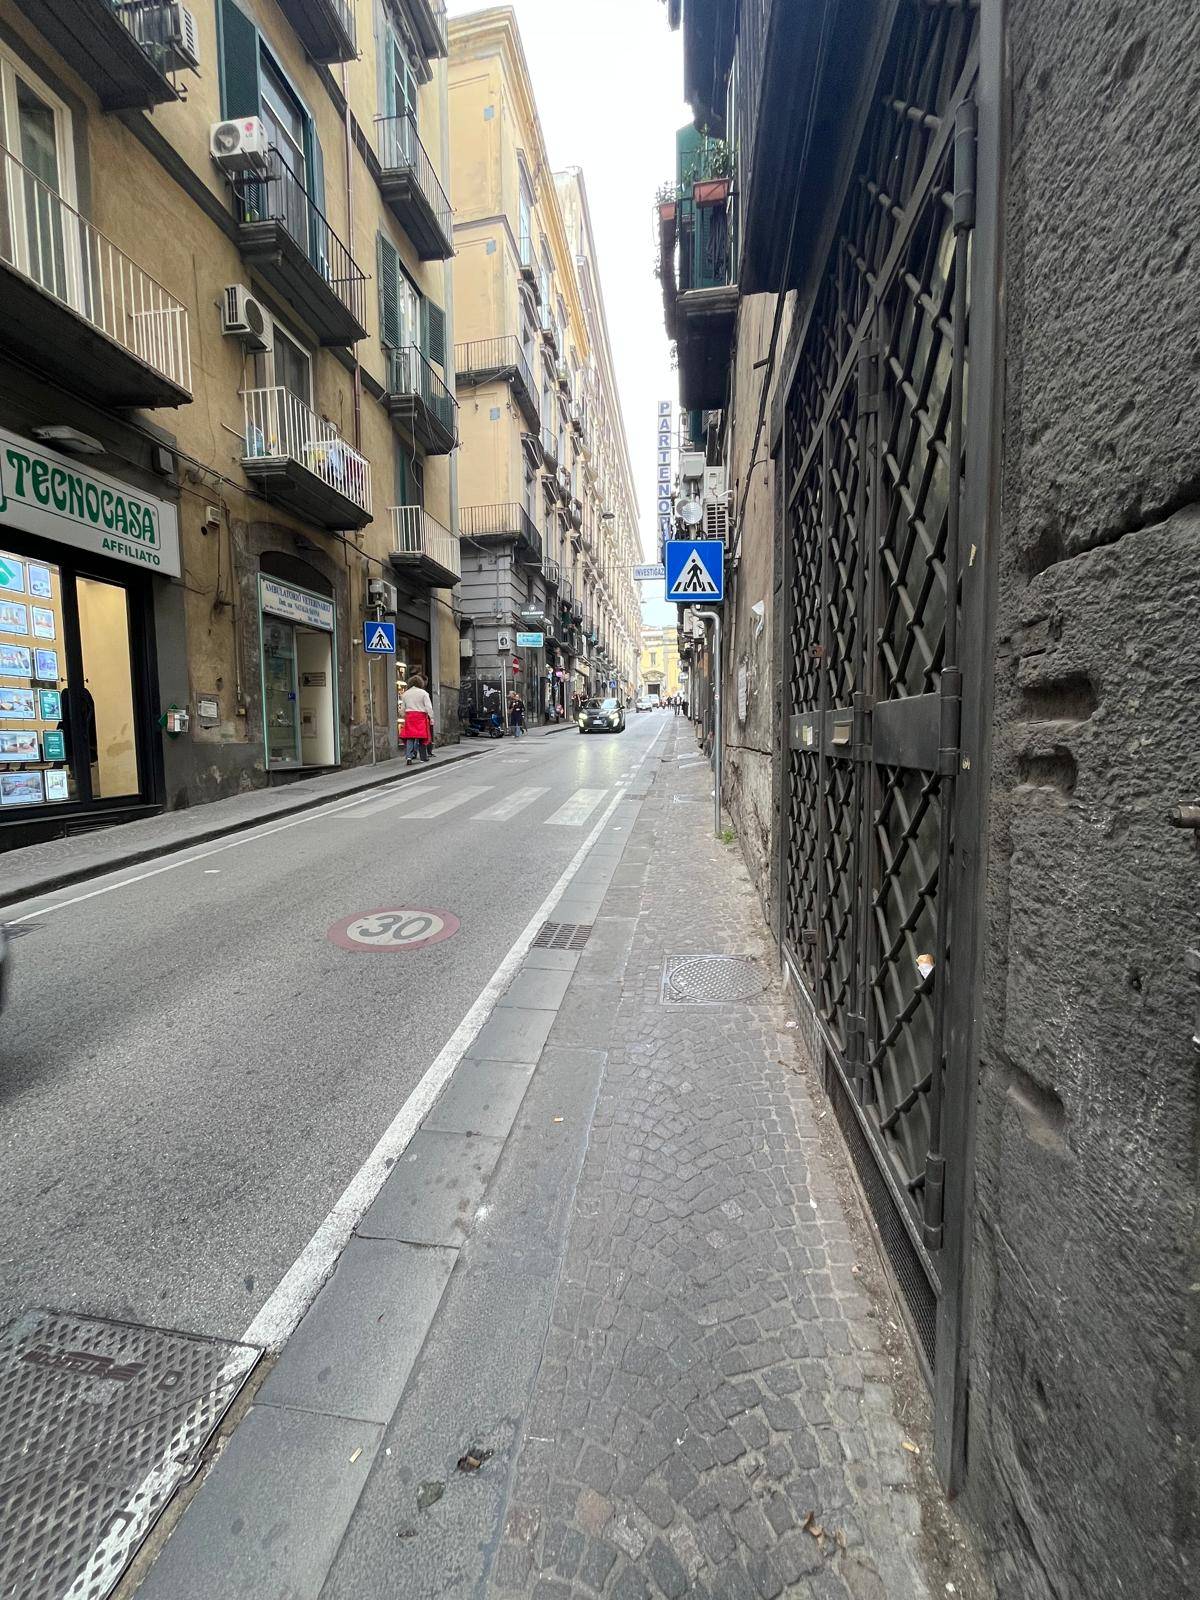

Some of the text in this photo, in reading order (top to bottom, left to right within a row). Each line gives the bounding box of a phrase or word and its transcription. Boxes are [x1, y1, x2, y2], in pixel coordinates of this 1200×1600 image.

[6, 449, 156, 545] TECNOCASA
[102, 537, 161, 566] AFFILIATO
[265, 583, 301, 602] AMBULATORIO
[302, 594, 331, 612] VETERINARIO
[358, 914, 433, 940] 30
